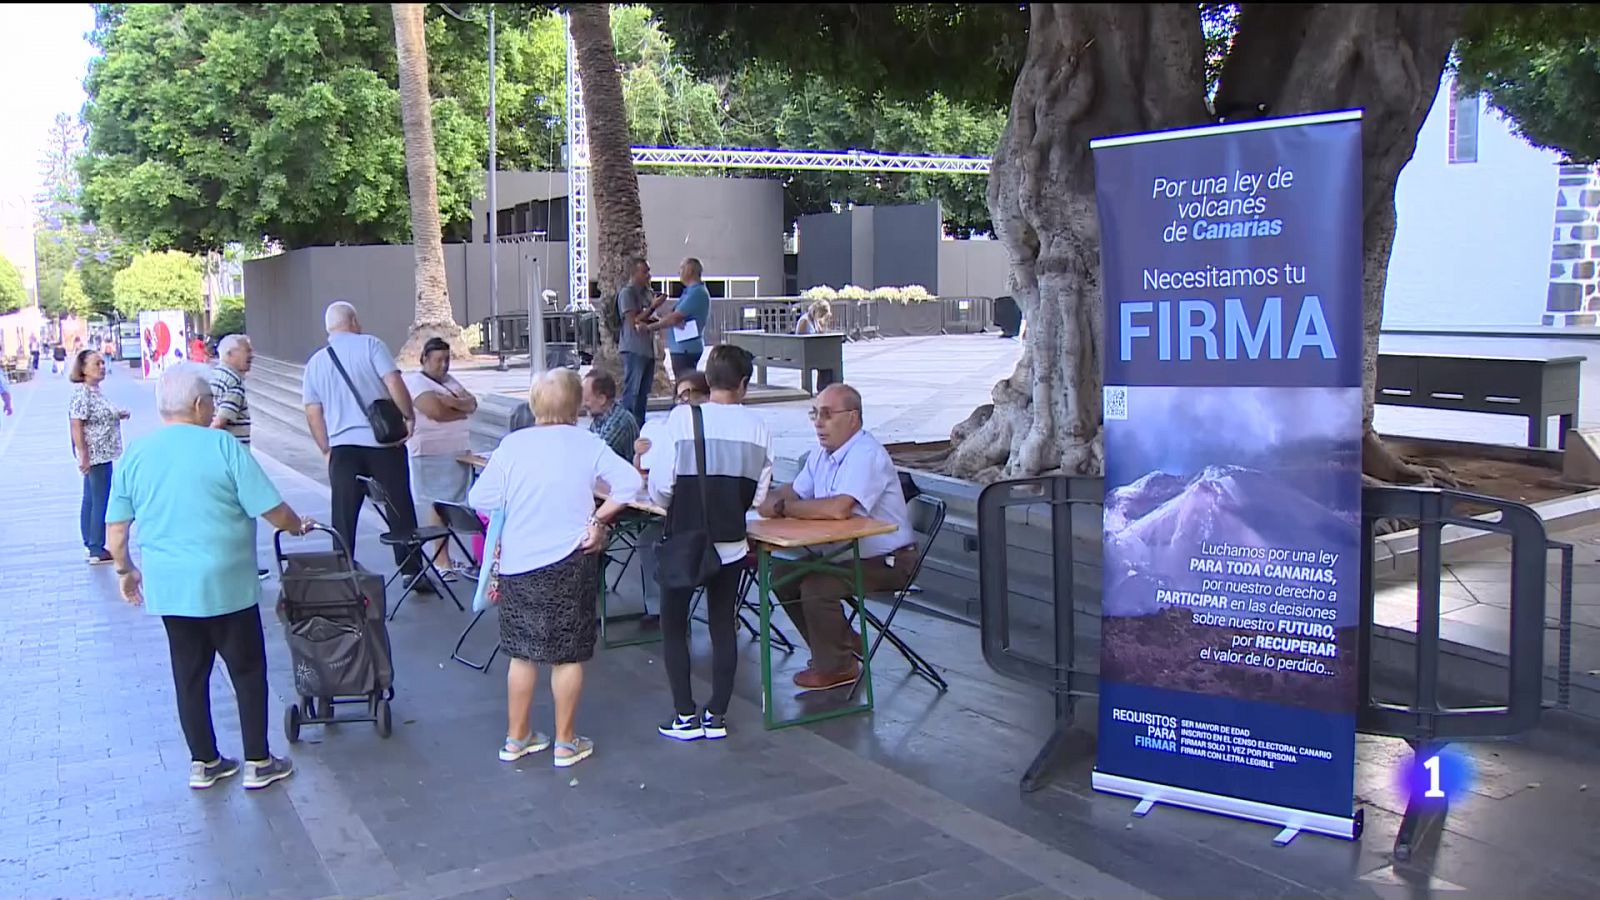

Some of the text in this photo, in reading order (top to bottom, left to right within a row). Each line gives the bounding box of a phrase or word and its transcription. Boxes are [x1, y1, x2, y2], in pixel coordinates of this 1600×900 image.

[1152, 166, 1294, 198] Por una ley de
[1178, 196, 1266, 218] volcanes
[1164, 215, 1283, 242] de Canarias
[1143, 263, 1306, 290] Necesitamos tu
[1120, 296, 1337, 360] FIRMA
[1201, 542, 1338, 568] Luchamos por una ley
[1189, 558, 1337, 586] PARA TODA CANARIAS,
[1202, 580, 1337, 602] por nuestro derecho a
[1156, 590, 1337, 620] PARTICIPAR en las decisiones
[1192, 612, 1336, 640] sobre nuestro FUTURO,
[1232, 634, 1336, 657] por RECUPERAR
[1200, 647, 1335, 676] el valor de lo perdido...
[1113, 708, 1177, 728] REQUISITOS
[1181, 719, 1250, 736] SER MAYOR DE EDAD
[1135, 736, 1176, 752] FIRMAR
[1148, 726, 1176, 740] PARA
[1181, 729, 1332, 760] INSCRITO EN EL CENSO ELECTORAL CANARIO
[1181, 738, 1206, 748] FIRMAR
[1207, 741, 1226, 752] SOLO
[1232, 745, 1246, 755] VEZ
[1247, 748, 1262, 758] POR
[1262, 750, 1296, 763] PERSONA
[1181, 747, 1274, 768] FIRMAR CON LETRA LEGIBLE
